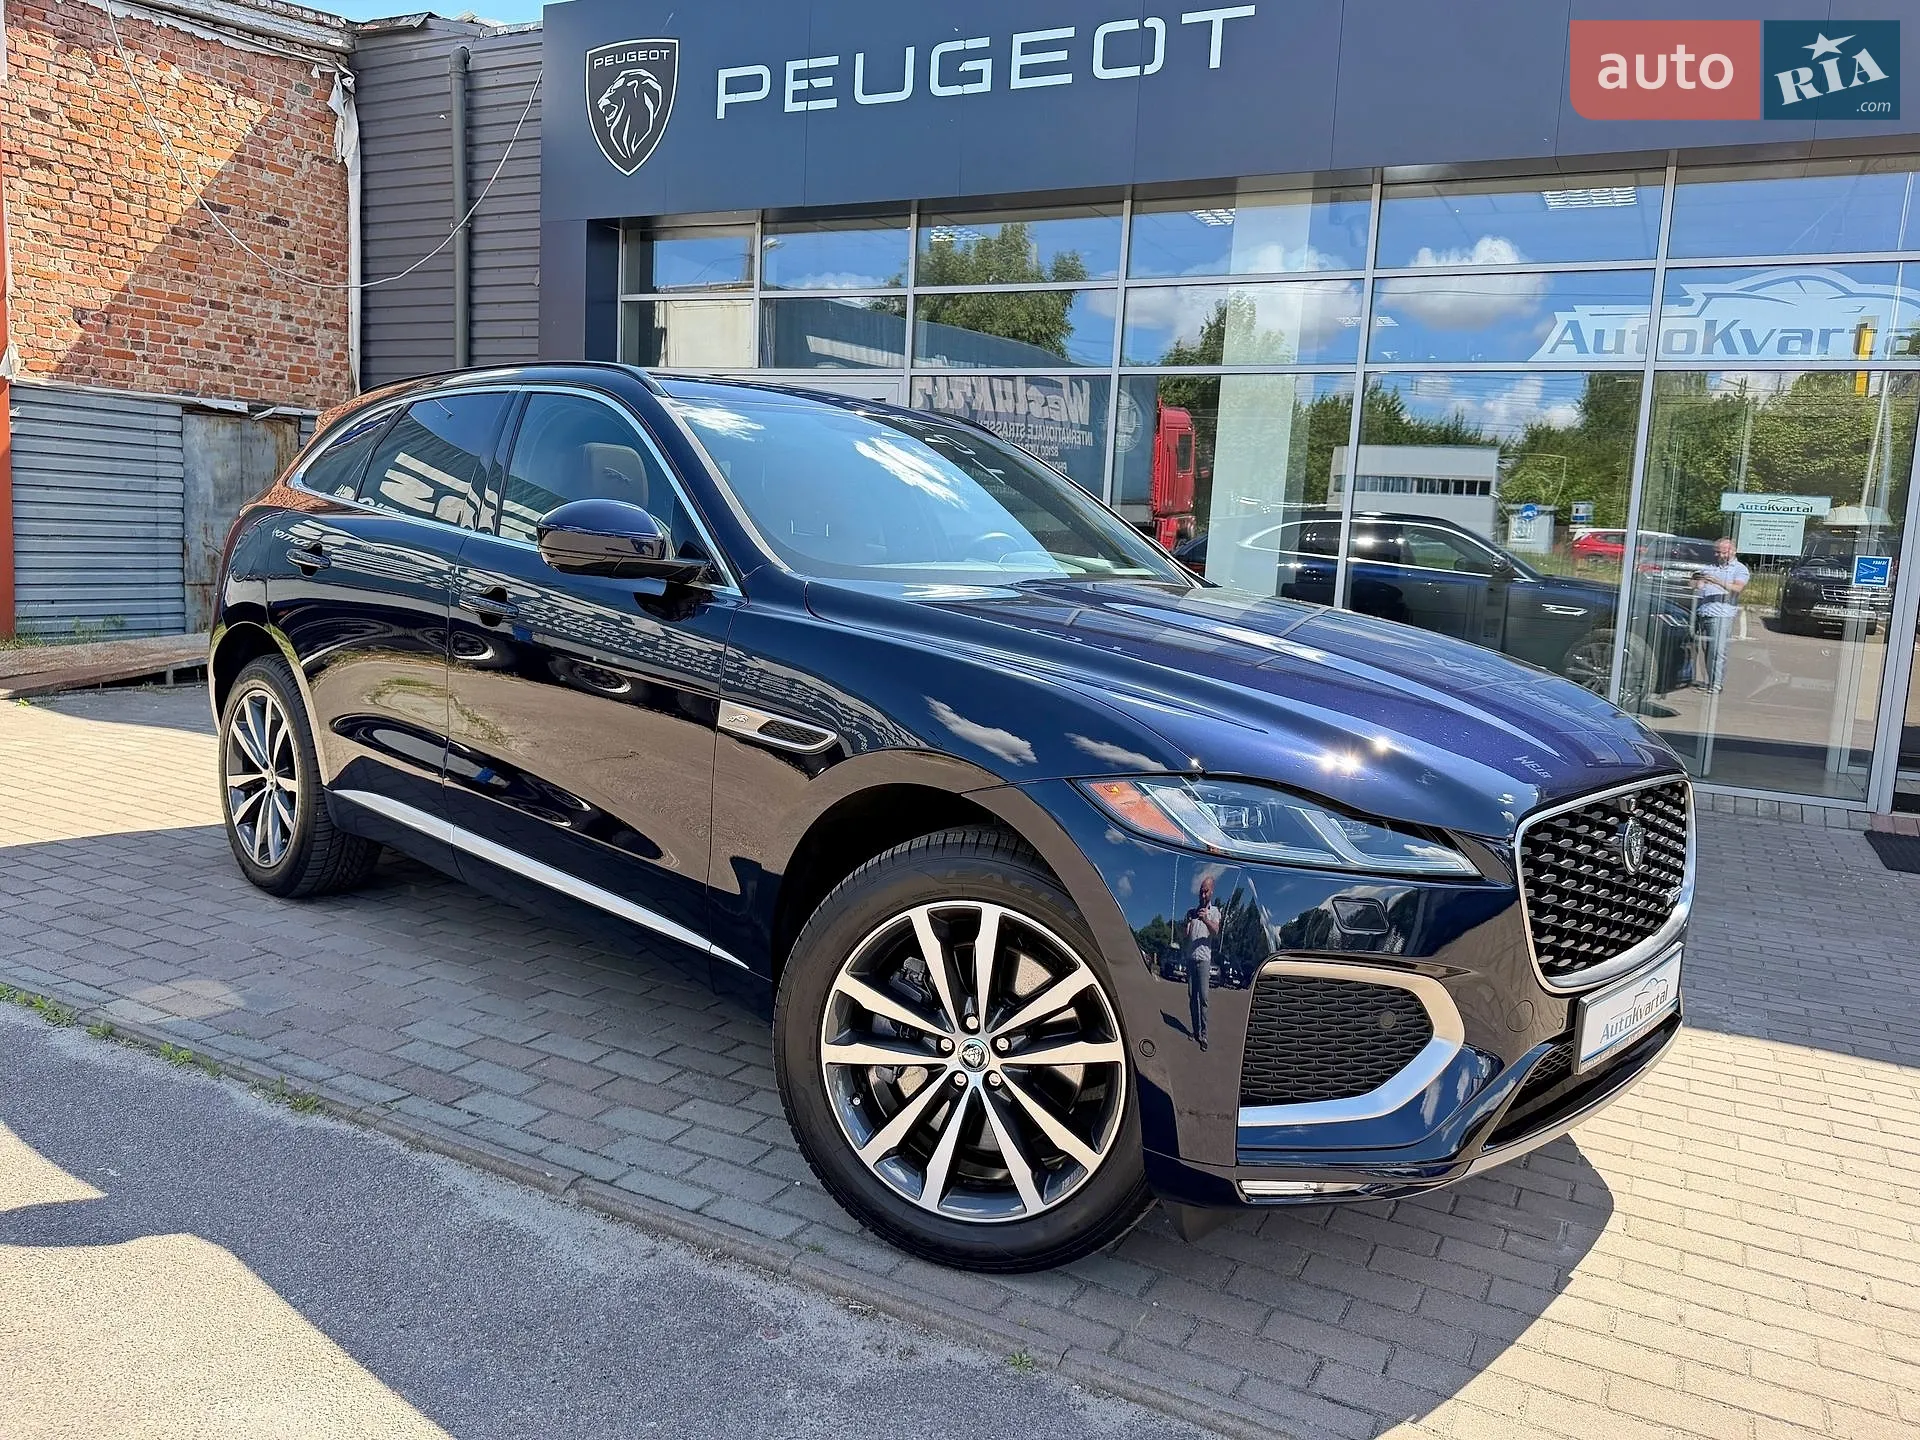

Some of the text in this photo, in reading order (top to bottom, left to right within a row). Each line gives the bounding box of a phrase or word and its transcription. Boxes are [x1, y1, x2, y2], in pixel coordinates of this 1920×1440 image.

[593, 49, 670, 70] PEUGEOT
[717, 4, 1257, 120] PEUGEOT
[1547, 319, 1920, 356] AutoKvarta
[1737, 502, 1814, 513] AutoKvartal
[1599, 983, 1669, 1044] AutoKvartal
